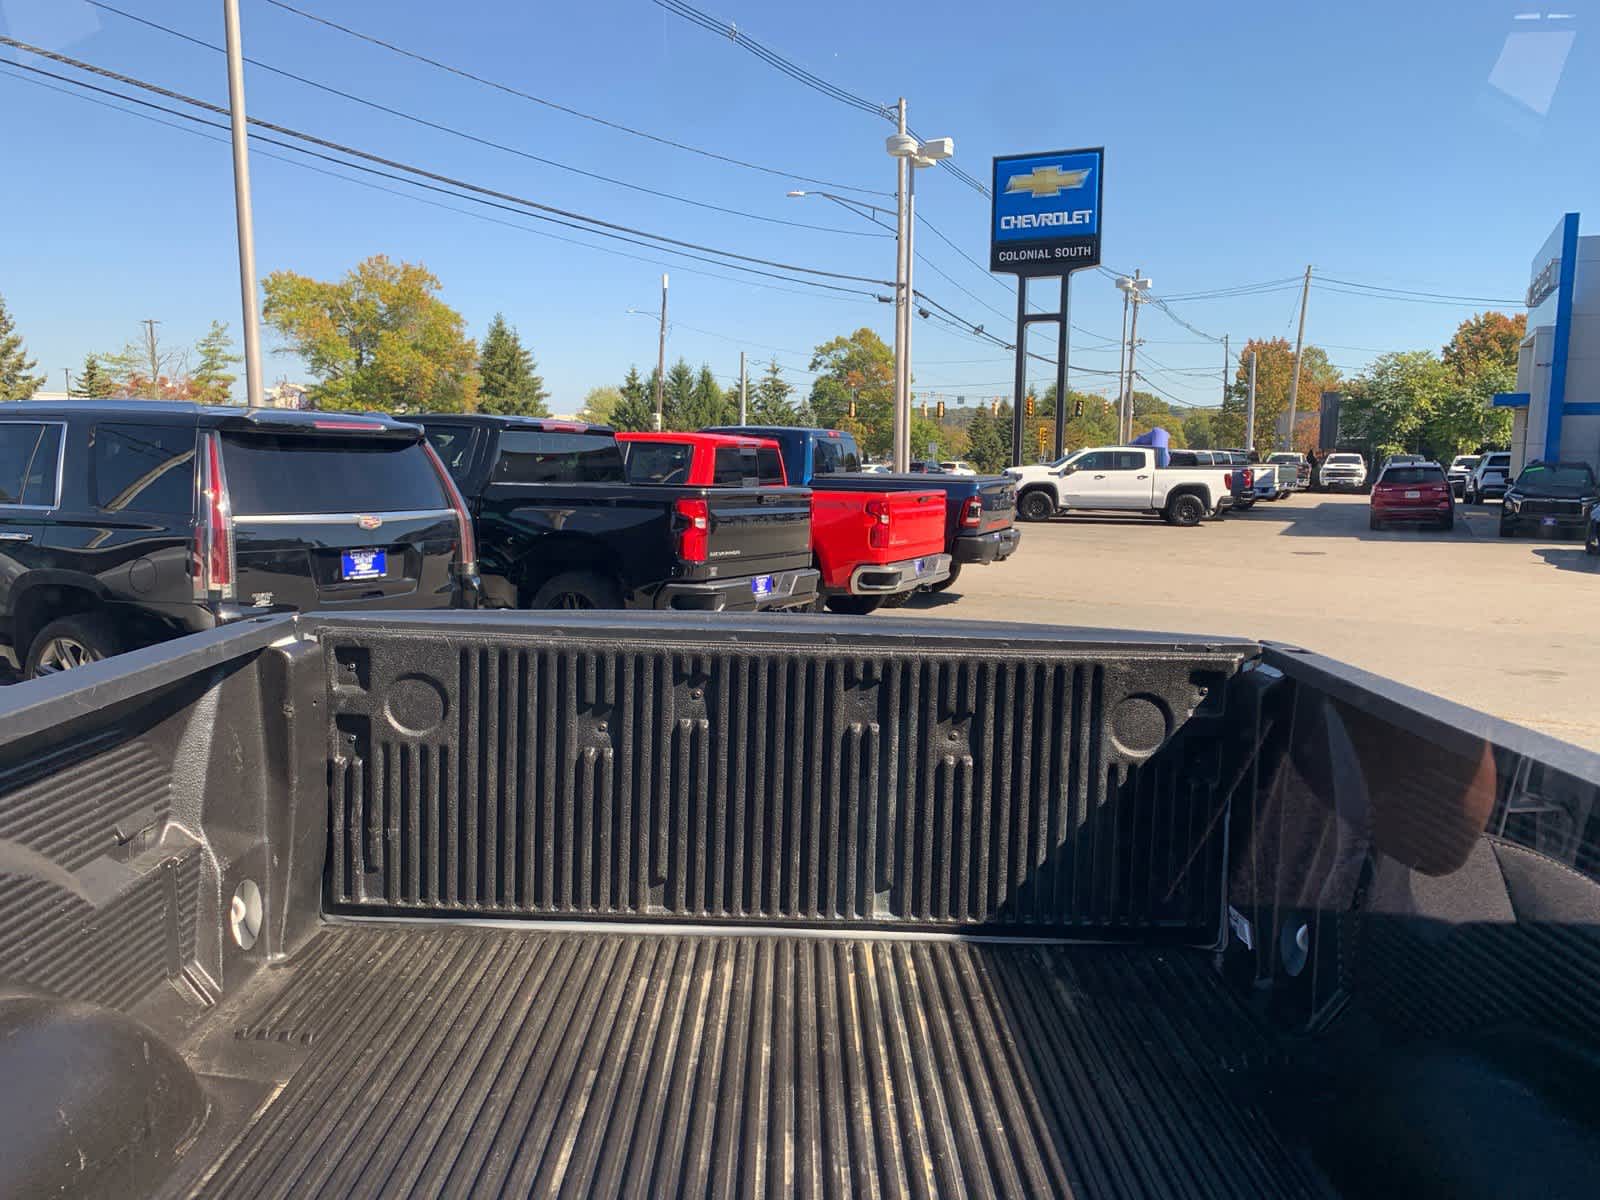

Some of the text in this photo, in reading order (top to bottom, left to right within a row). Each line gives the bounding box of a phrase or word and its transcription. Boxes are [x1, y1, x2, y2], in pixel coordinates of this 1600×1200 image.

[1000, 210, 1093, 230] CHEVROLET
[998, 246, 1092, 262] COLONIAL SOUTH
